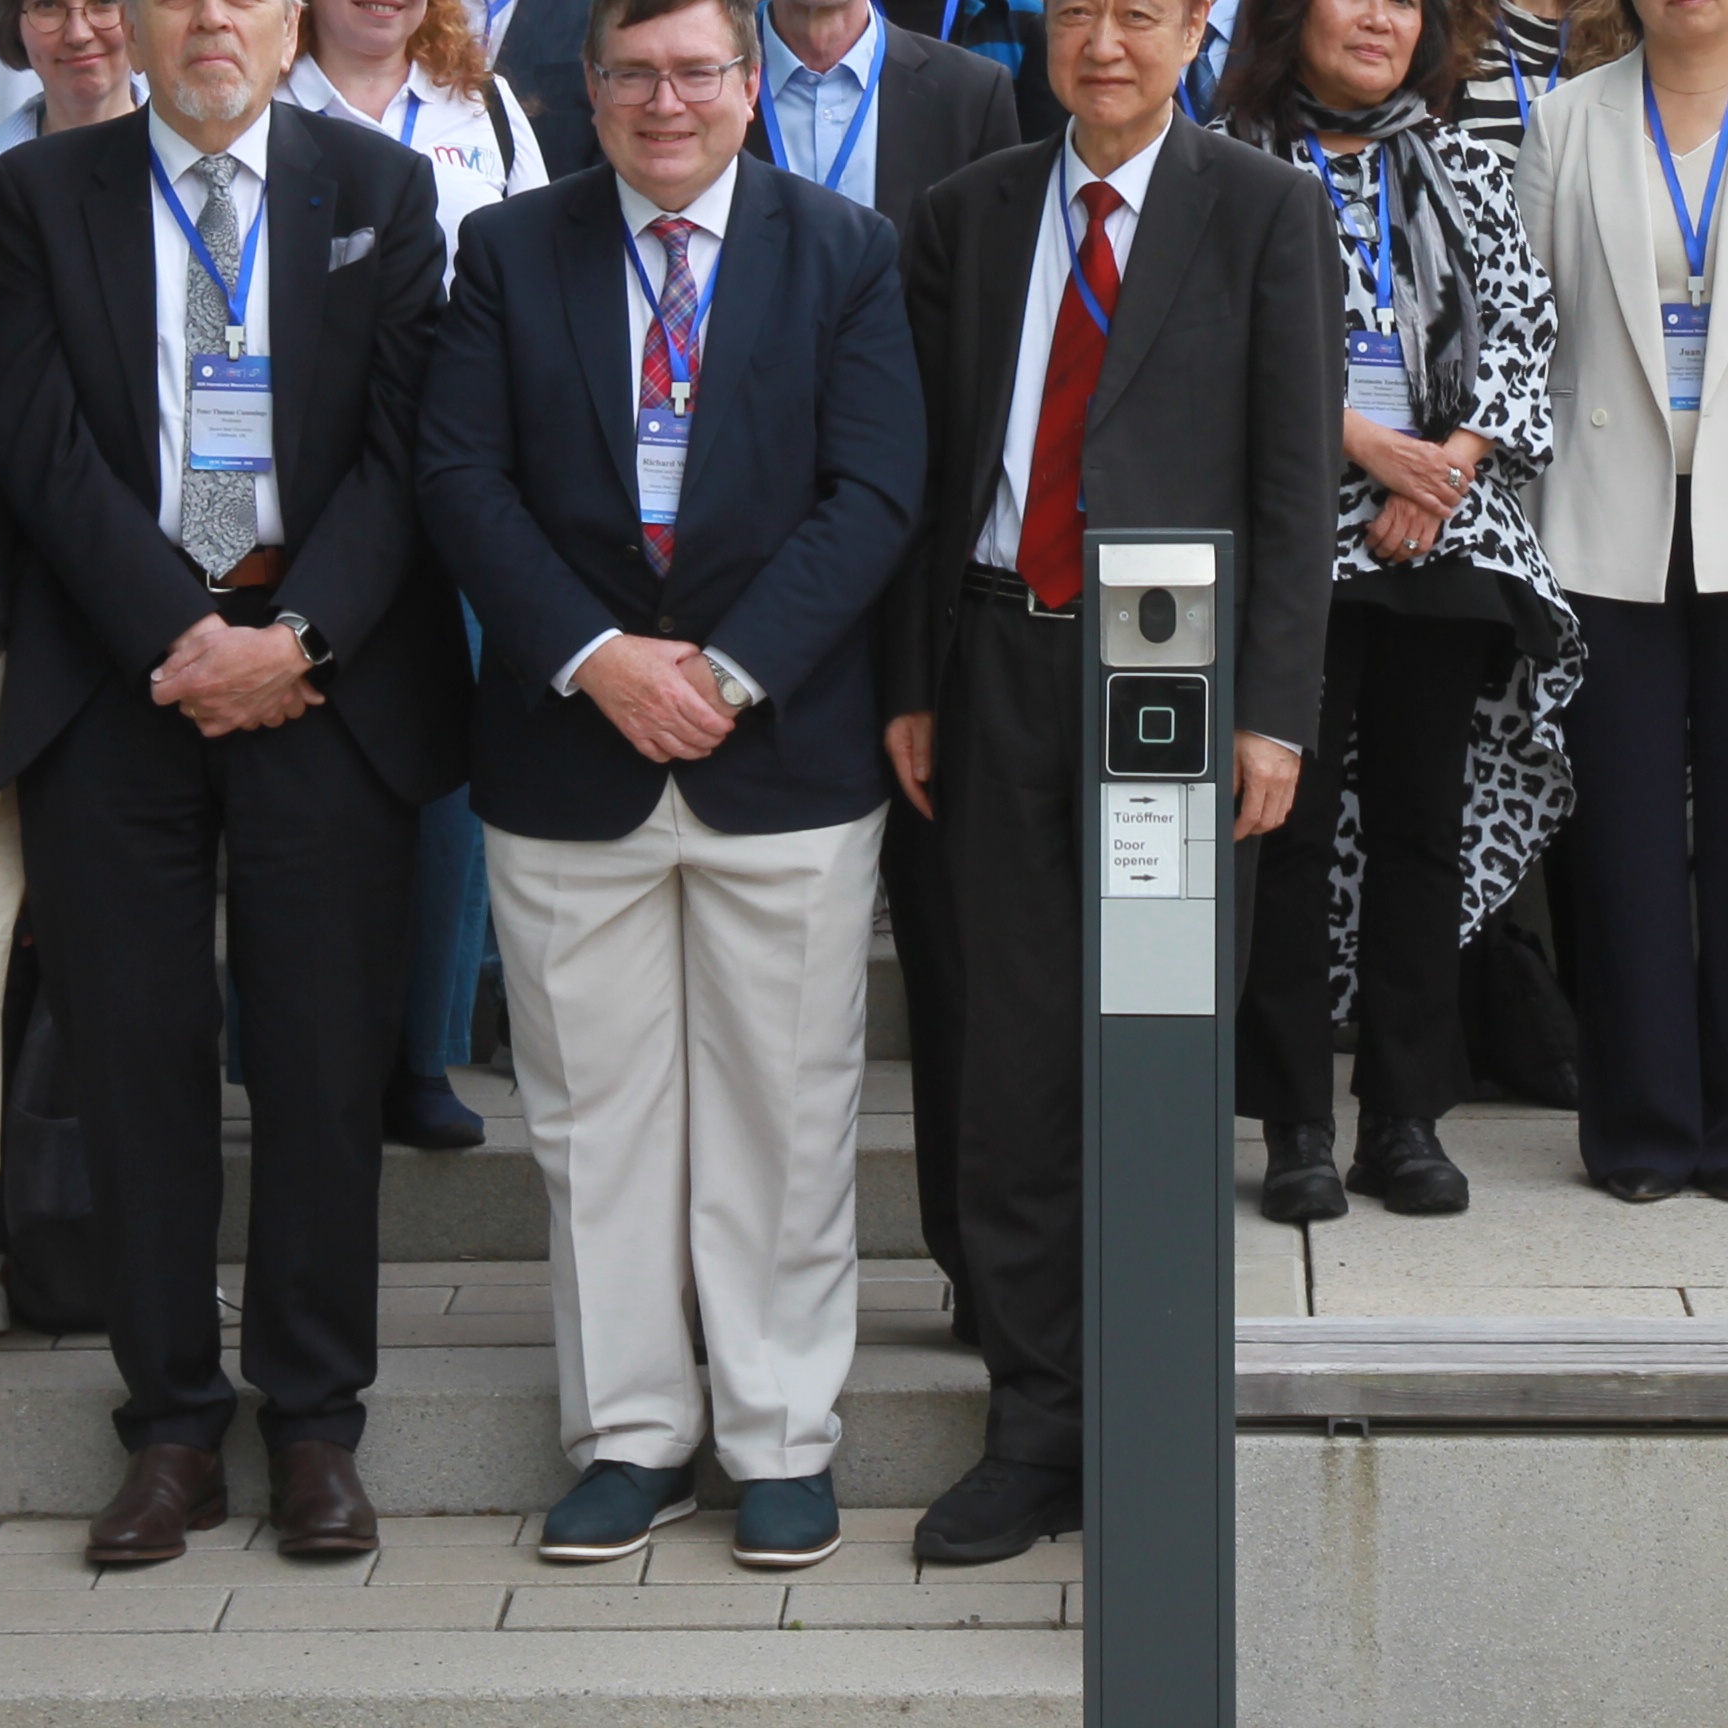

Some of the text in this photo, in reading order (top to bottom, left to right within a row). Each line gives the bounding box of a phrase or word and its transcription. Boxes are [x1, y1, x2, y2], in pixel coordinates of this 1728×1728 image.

[1113, 812, 1175, 824] Türöffner
[1113, 839, 1146, 851] Door
[1113, 856, 1160, 869] opener
